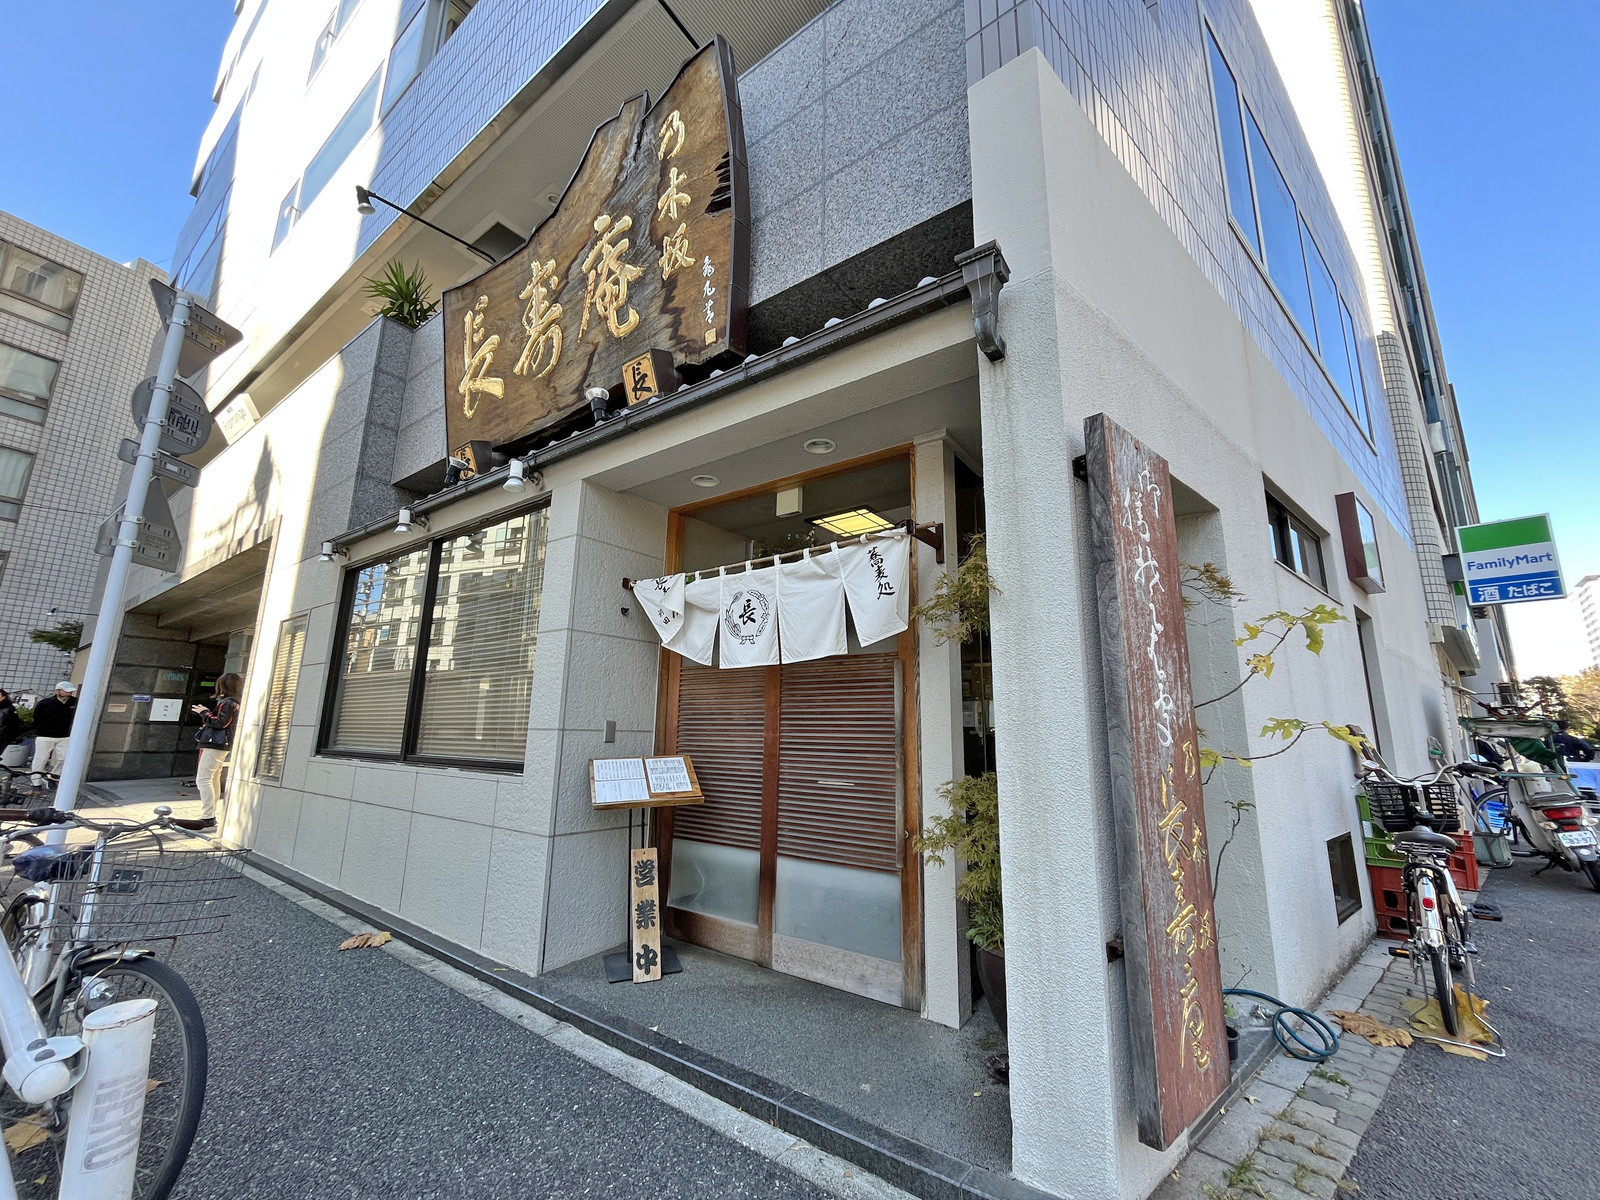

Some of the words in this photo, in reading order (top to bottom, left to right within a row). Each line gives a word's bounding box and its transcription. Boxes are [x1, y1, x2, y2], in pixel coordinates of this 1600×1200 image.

[657, 109, 696, 281] 乃木坂
[458, 213, 645, 419] 長寿庵
[632, 361, 652, 400] 長
[866, 545, 896, 601] 蕎麦処
[1467, 552, 1553, 571] FamilyMart
[739, 598, 757, 625] 長
[1478, 586, 1500, 602] 酒
[1507, 582, 1555, 598] たばこ
[1182, 740, 1215, 950] 乃木坂
[634, 859, 658, 976] 営業中
